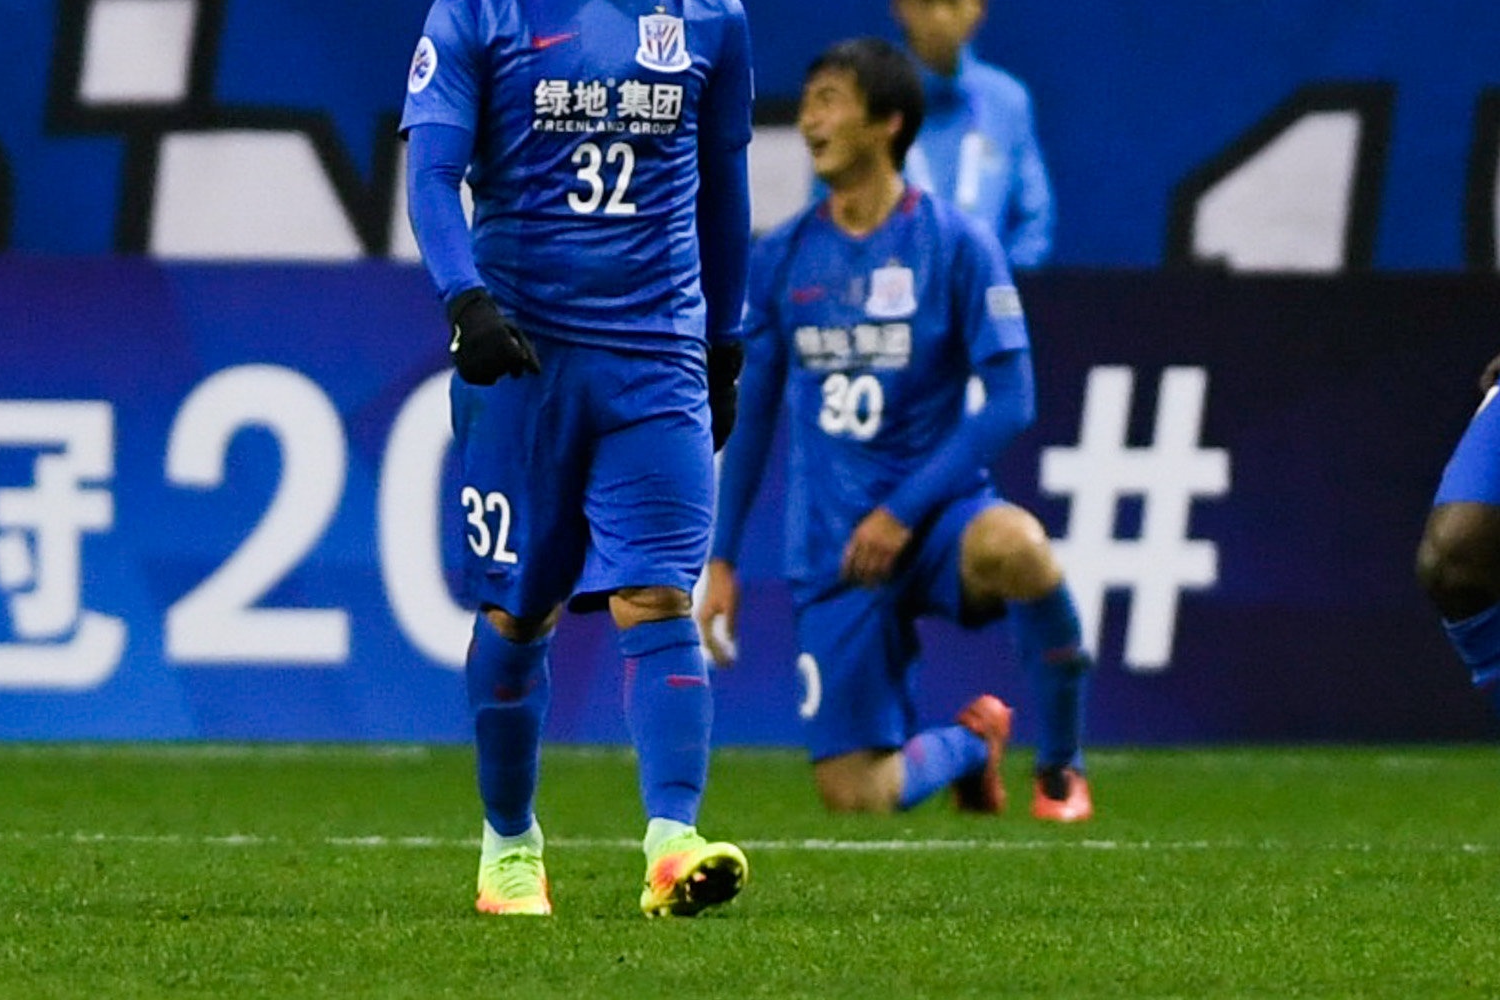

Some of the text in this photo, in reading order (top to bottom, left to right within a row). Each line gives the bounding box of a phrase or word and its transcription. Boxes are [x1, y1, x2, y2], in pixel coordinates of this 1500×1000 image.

[566, 141, 638, 216] 32
[818, 372, 884, 441] 30
[460, 485, 519, 565] 32
